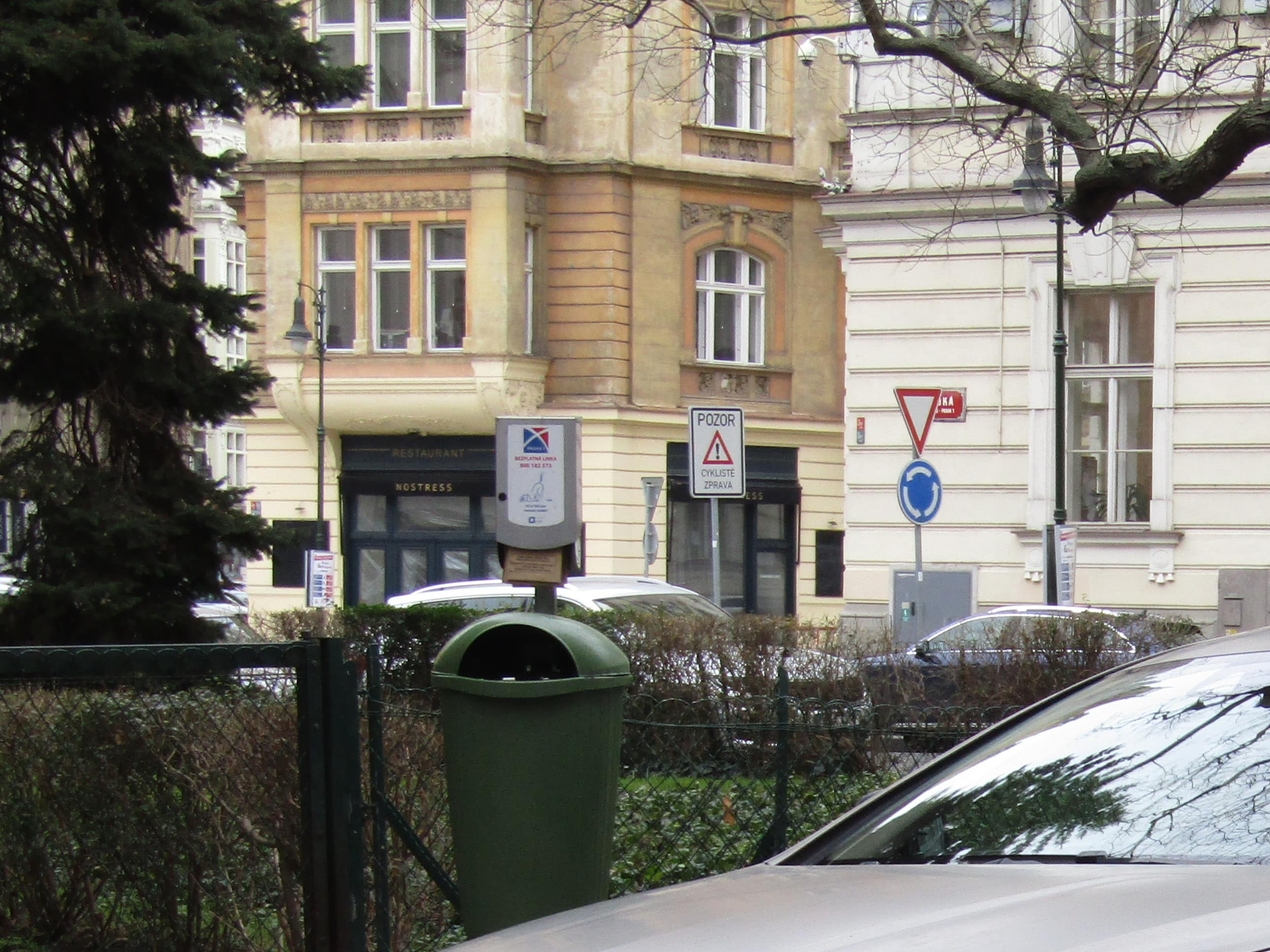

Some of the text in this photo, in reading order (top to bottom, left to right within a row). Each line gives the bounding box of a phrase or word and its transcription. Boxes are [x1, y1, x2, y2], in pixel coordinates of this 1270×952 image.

[697, 413, 736, 427] POZOR
[392, 448, 465, 458] RESTAURANT
[701, 468, 735, 478] CYKLISTÉ
[395, 482, 453, 493] NOSTRESS
[704, 481, 733, 490] ZPRAVA
[746, 492, 763, 500] ESS
